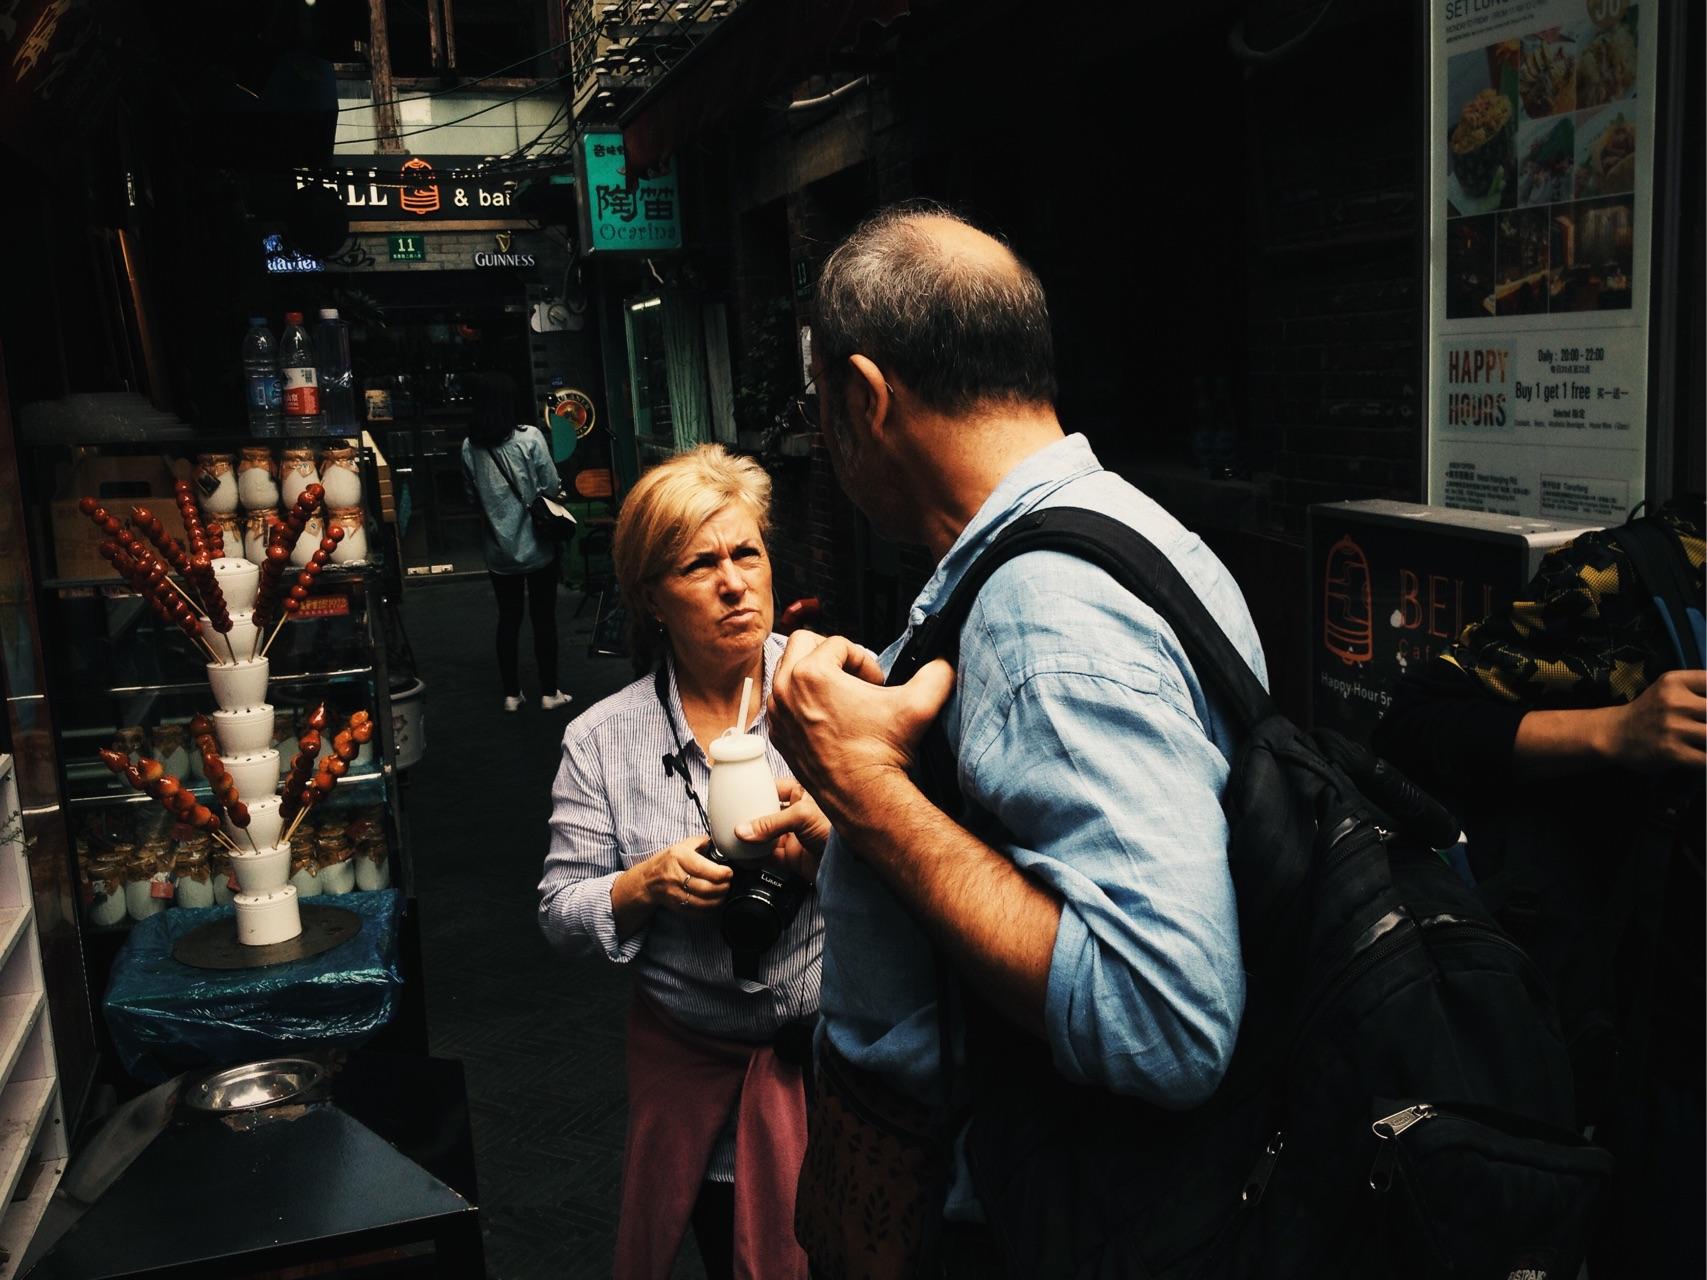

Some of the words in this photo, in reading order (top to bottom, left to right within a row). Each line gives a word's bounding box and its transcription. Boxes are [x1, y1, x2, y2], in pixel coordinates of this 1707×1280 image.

[453, 187, 470, 207] &
[595, 184, 675, 222] 陶笛
[599, 222, 677, 241] Ocarina
[398, 238, 416, 252] 11
[474, 251, 536, 267] GUINNESS
[1448, 349, 1509, 383] HAPPY
[1515, 381, 1533, 402] Buy
[1536, 381, 1541, 399] 1
[1544, 383, 1559, 403] get
[1562, 381, 1567, 400] 1
[1571, 381, 1591, 400] free
[1448, 393, 1507, 427] HOURS
[1320, 671, 1352, 697] Happy
[1353, 682, 1379, 703] Hour
